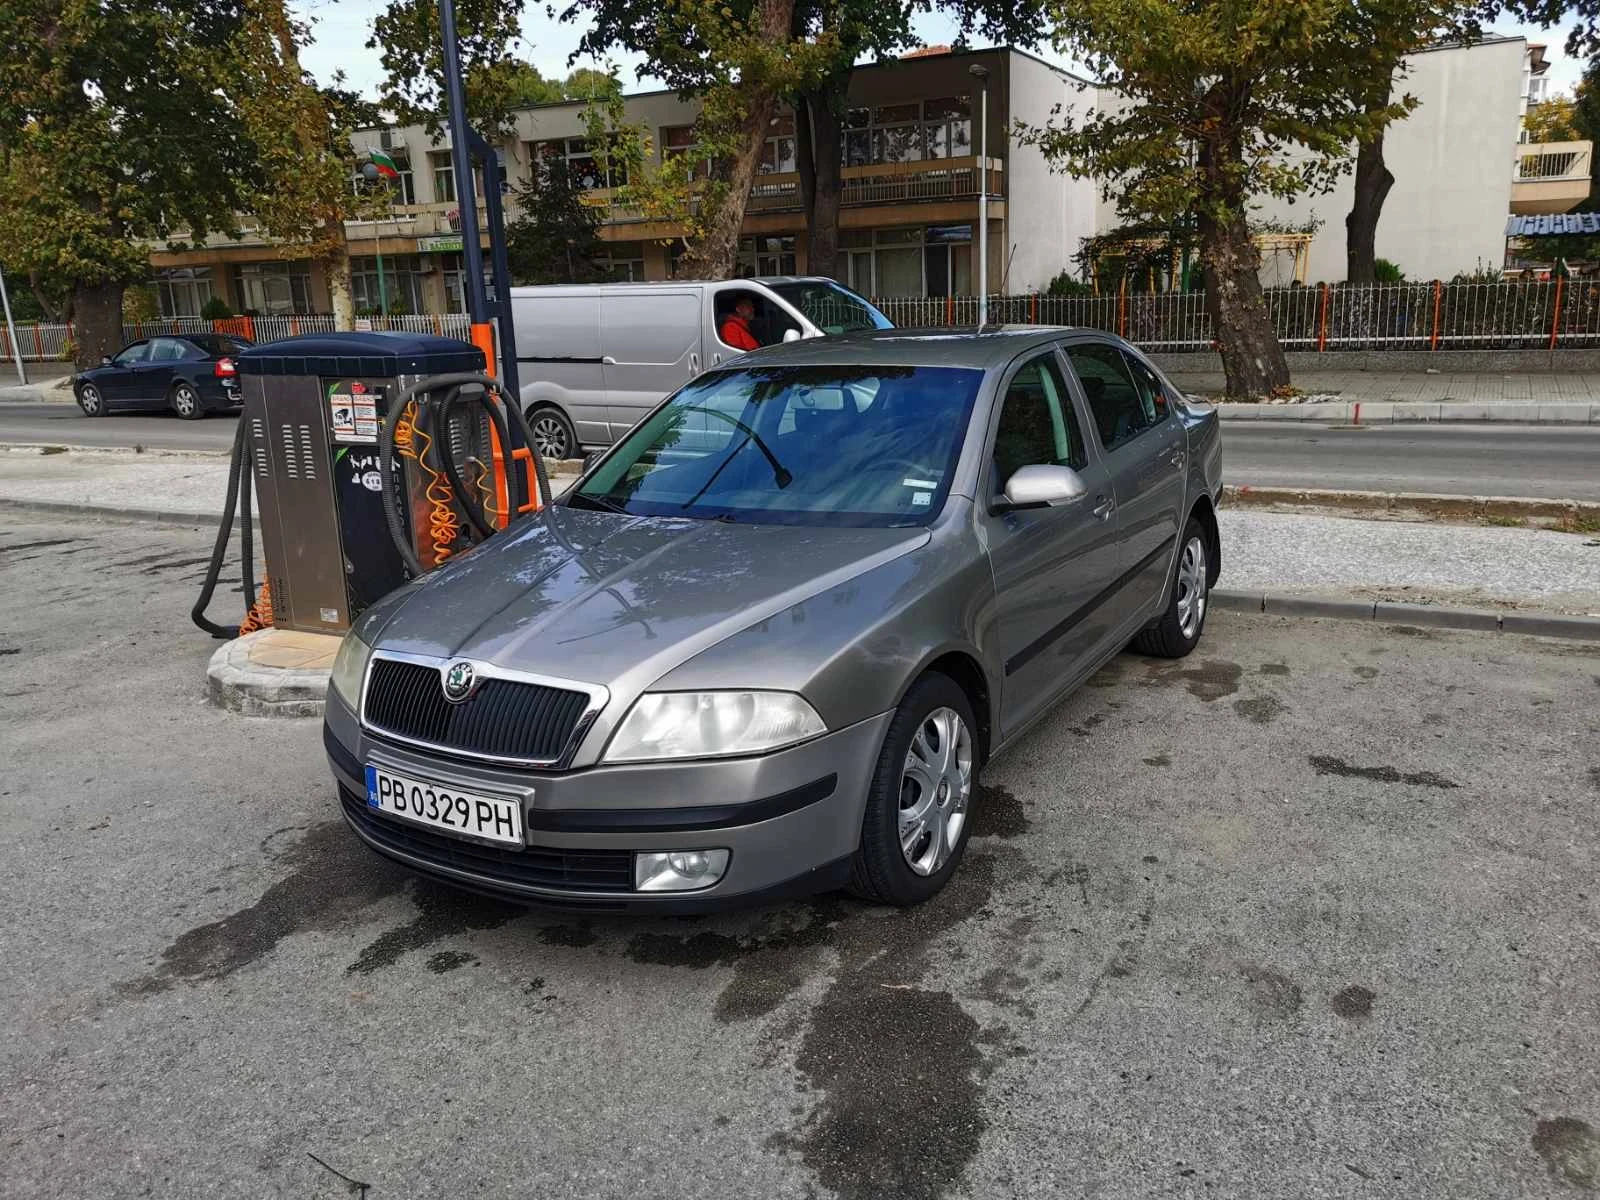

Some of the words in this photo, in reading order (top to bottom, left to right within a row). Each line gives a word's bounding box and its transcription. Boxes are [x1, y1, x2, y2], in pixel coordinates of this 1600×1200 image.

[379, 775, 407, 811] PB
[411, 786, 470, 828] 0329
[475, 800, 514, 837] PH
